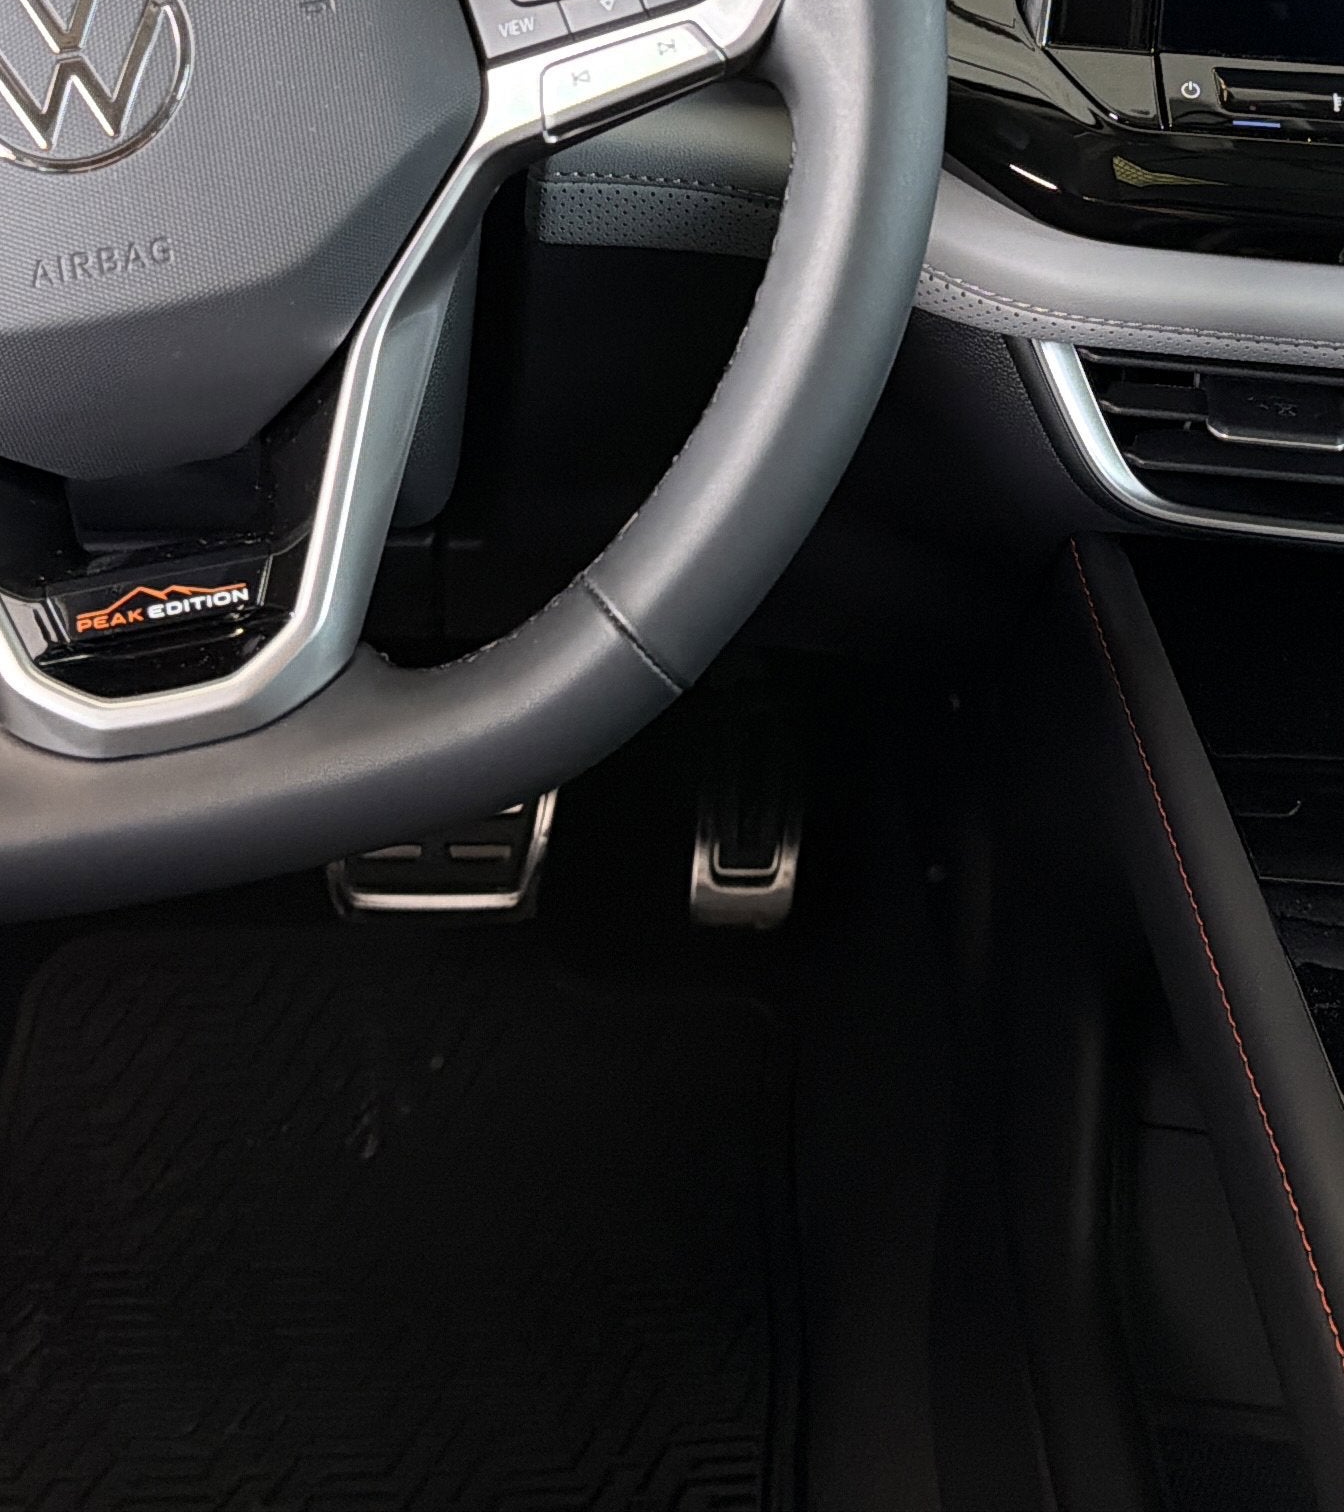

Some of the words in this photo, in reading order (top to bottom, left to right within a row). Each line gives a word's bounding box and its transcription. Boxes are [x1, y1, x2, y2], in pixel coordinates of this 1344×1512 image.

[498, 16, 536, 38] VIEW
[30, 234, 175, 288] AIRBAG
[77, 609, 144, 633] PEAK
[148, 588, 249, 619] EDITION
